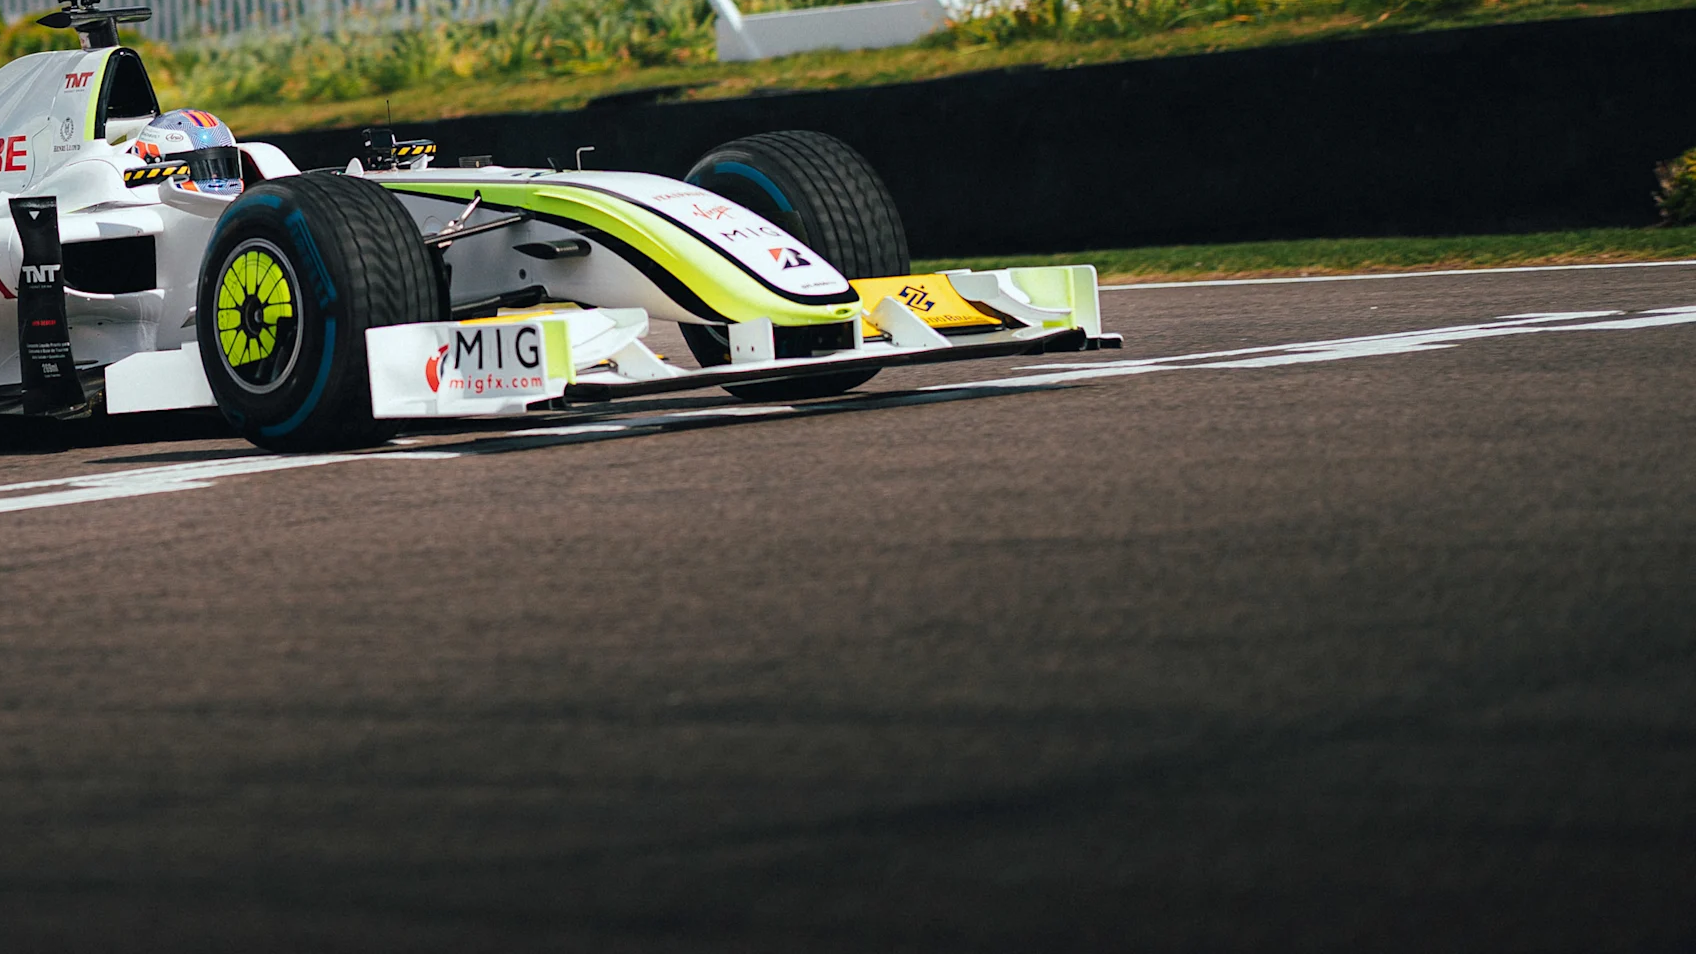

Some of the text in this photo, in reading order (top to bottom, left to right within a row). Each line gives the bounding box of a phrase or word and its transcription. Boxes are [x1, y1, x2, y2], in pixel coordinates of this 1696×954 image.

[64, 71, 95, 89] TNT
[720, 227, 781, 242] MIG
[22, 264, 61, 283] TNT
[454, 326, 540, 370] MIG
[449, 373, 543, 394] migfx.com
